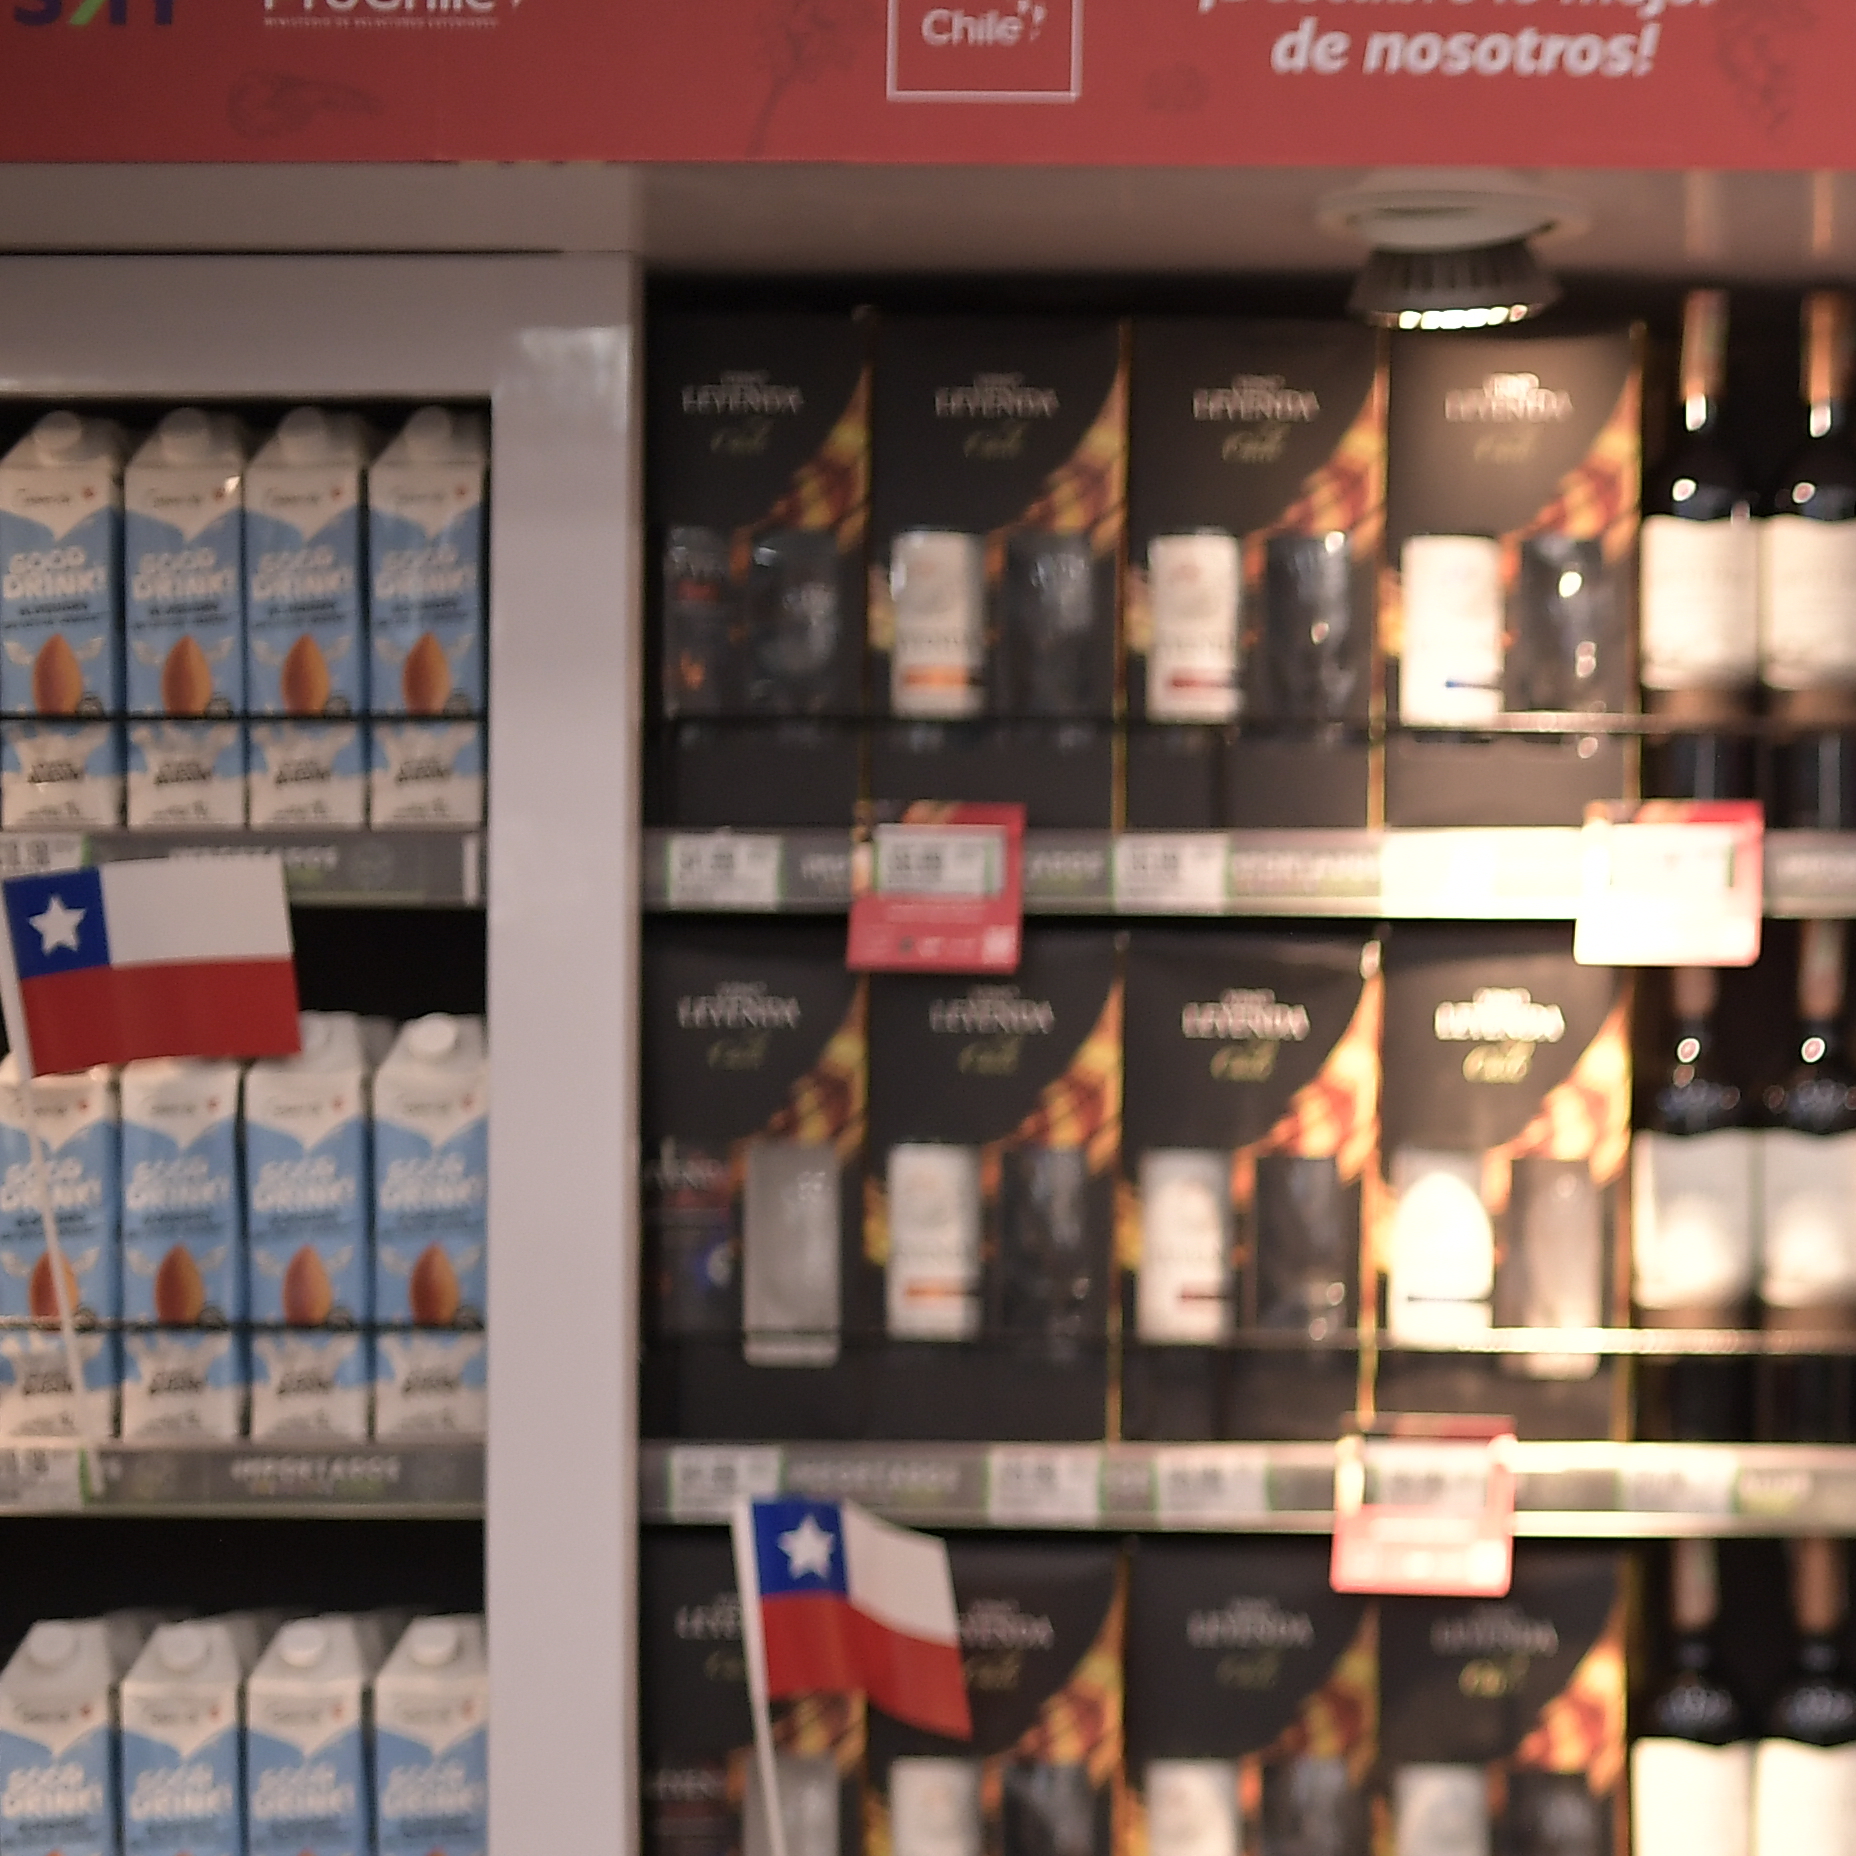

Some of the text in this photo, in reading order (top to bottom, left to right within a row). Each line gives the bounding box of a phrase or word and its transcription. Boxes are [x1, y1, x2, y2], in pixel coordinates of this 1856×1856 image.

[920, 7, 1023, 47] Chile
[1270, 16, 1662, 78] de nosotros!
